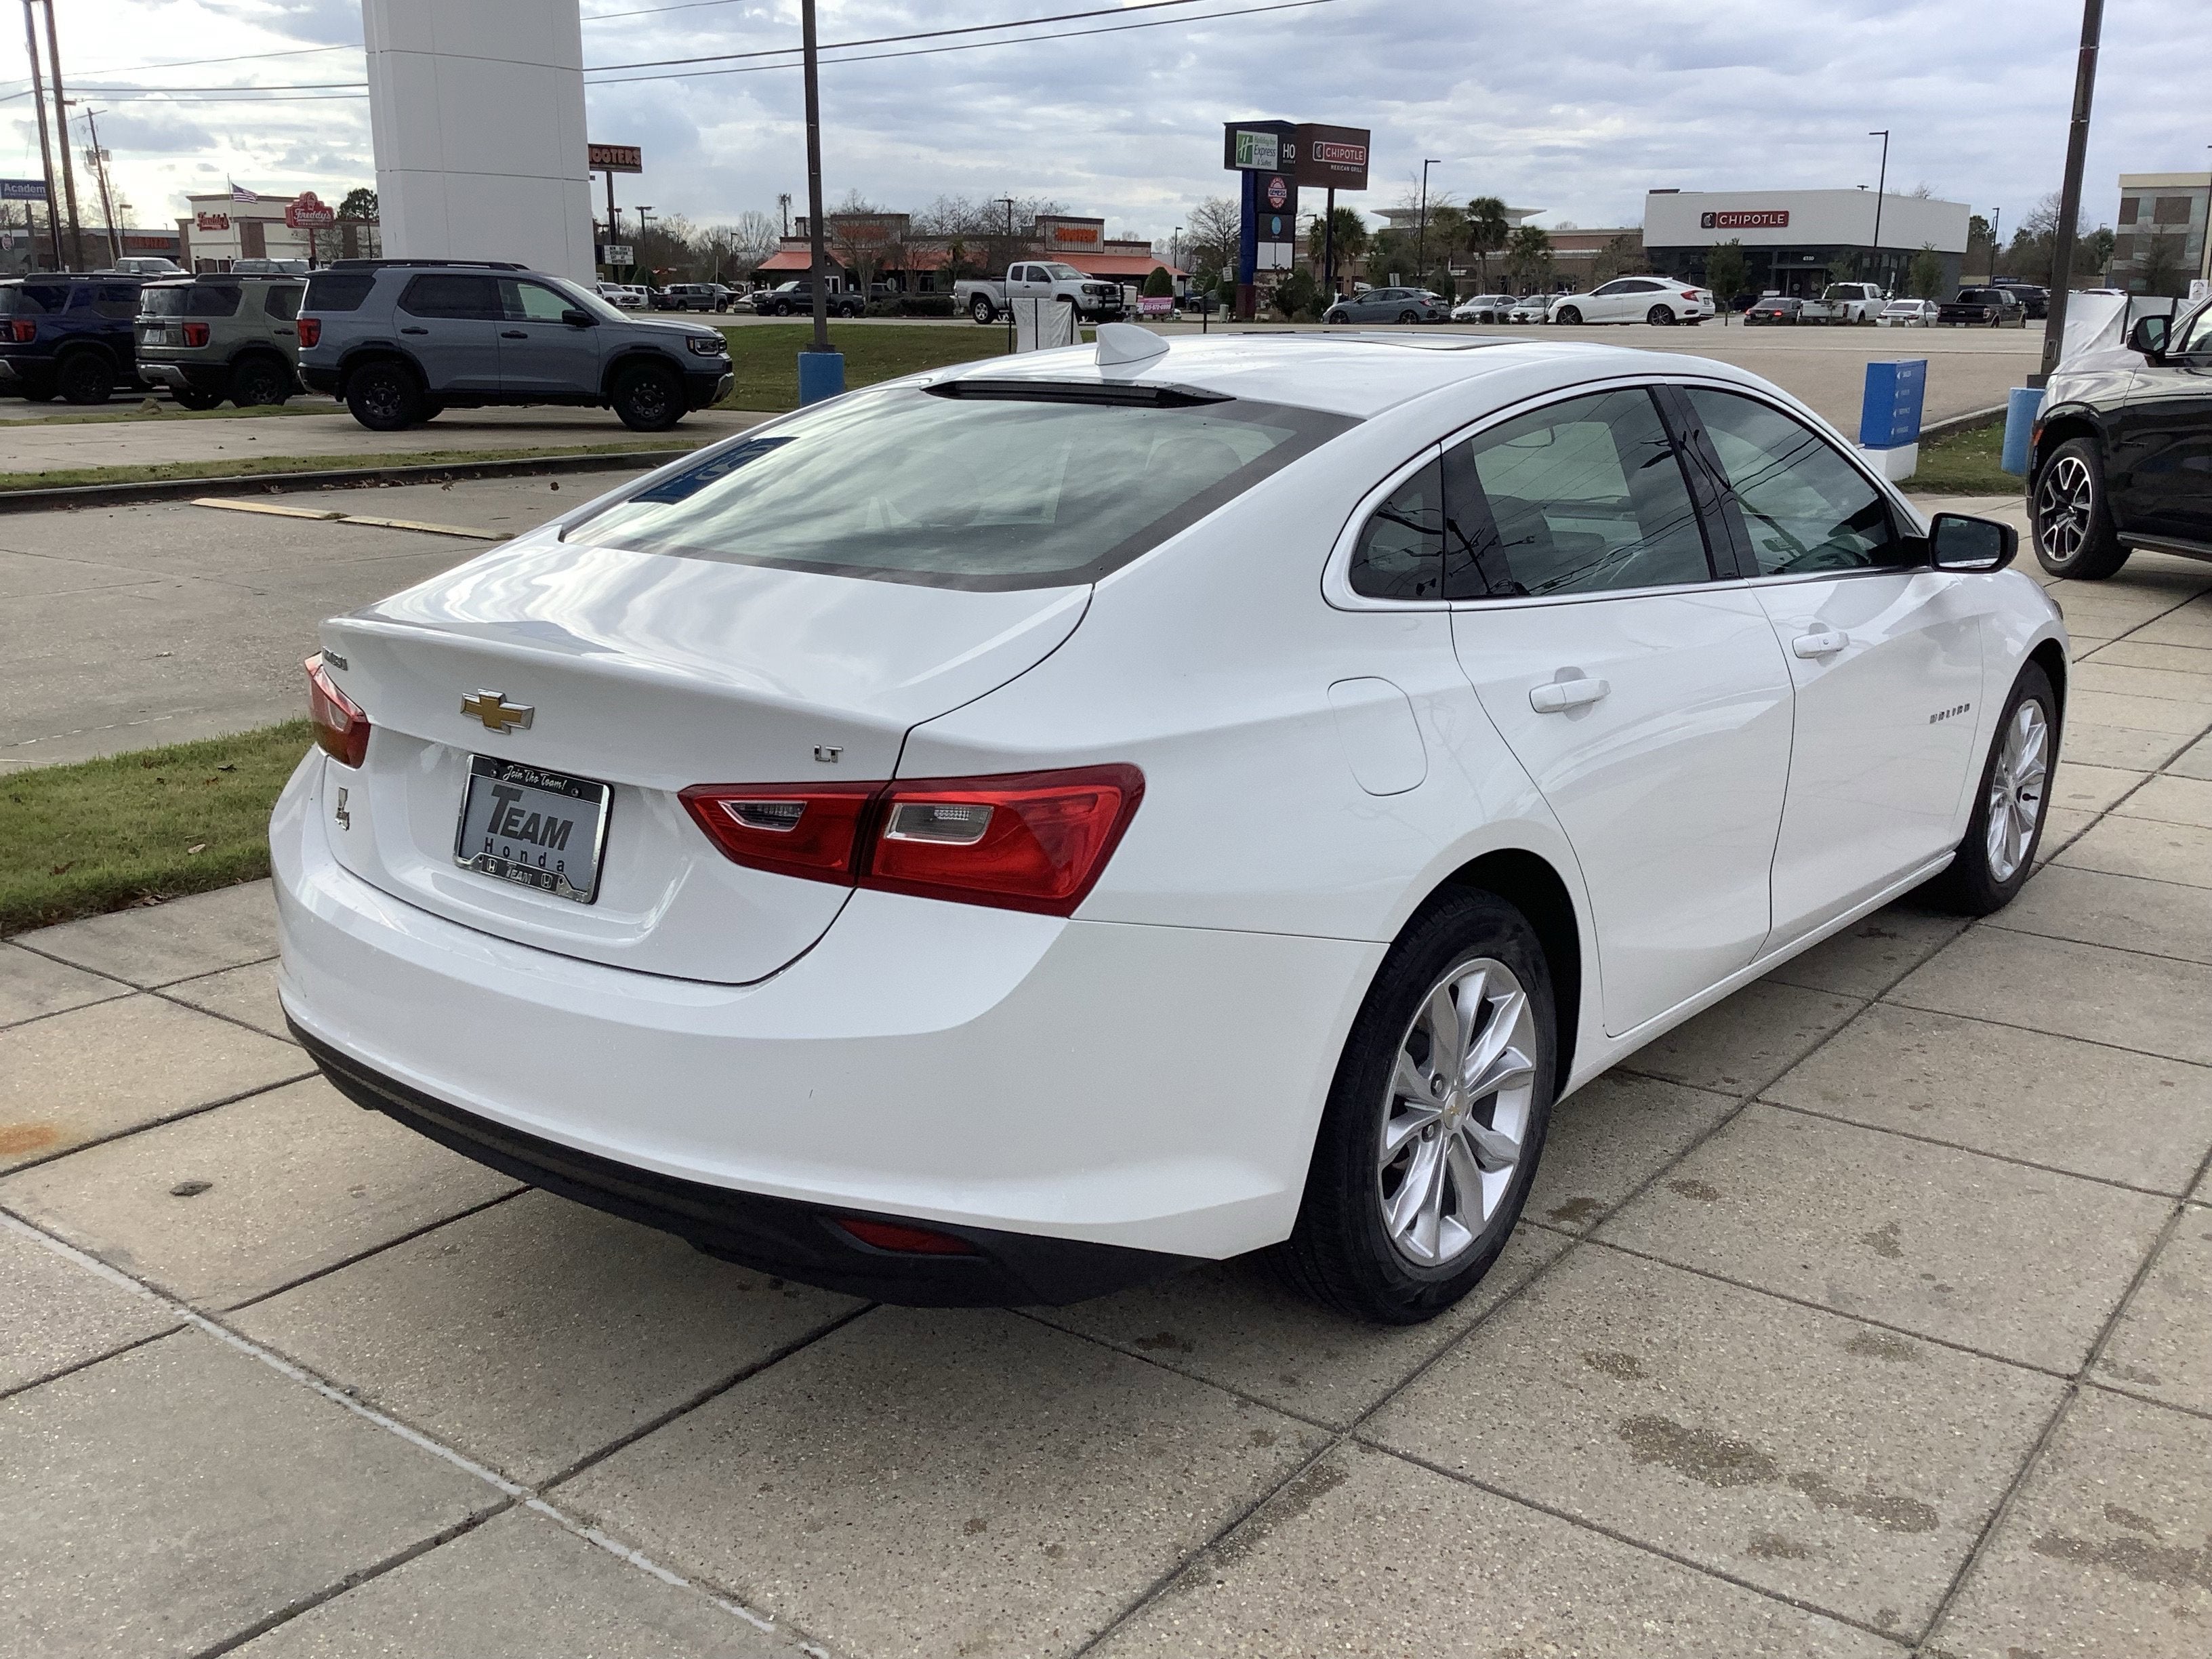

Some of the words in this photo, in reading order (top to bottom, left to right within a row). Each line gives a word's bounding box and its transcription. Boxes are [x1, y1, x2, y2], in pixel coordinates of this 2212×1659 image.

[589, 147, 640, 165] OOTERS
[1254, 144, 1276, 158] Express
[1326, 148, 1364, 161] CHIPOTLE
[294, 208, 331, 222] Freddy's
[1719, 214, 1785, 224] CHIPOTLE
[815, 744, 843, 763] LT
[503, 765, 523, 781] Join
[525, 770, 539, 783] The
[540, 773, 567, 790] Team!
[487, 784, 574, 851] TEAM
[485, 837, 565, 873] Honda
[506, 862, 533, 884] TEAM
